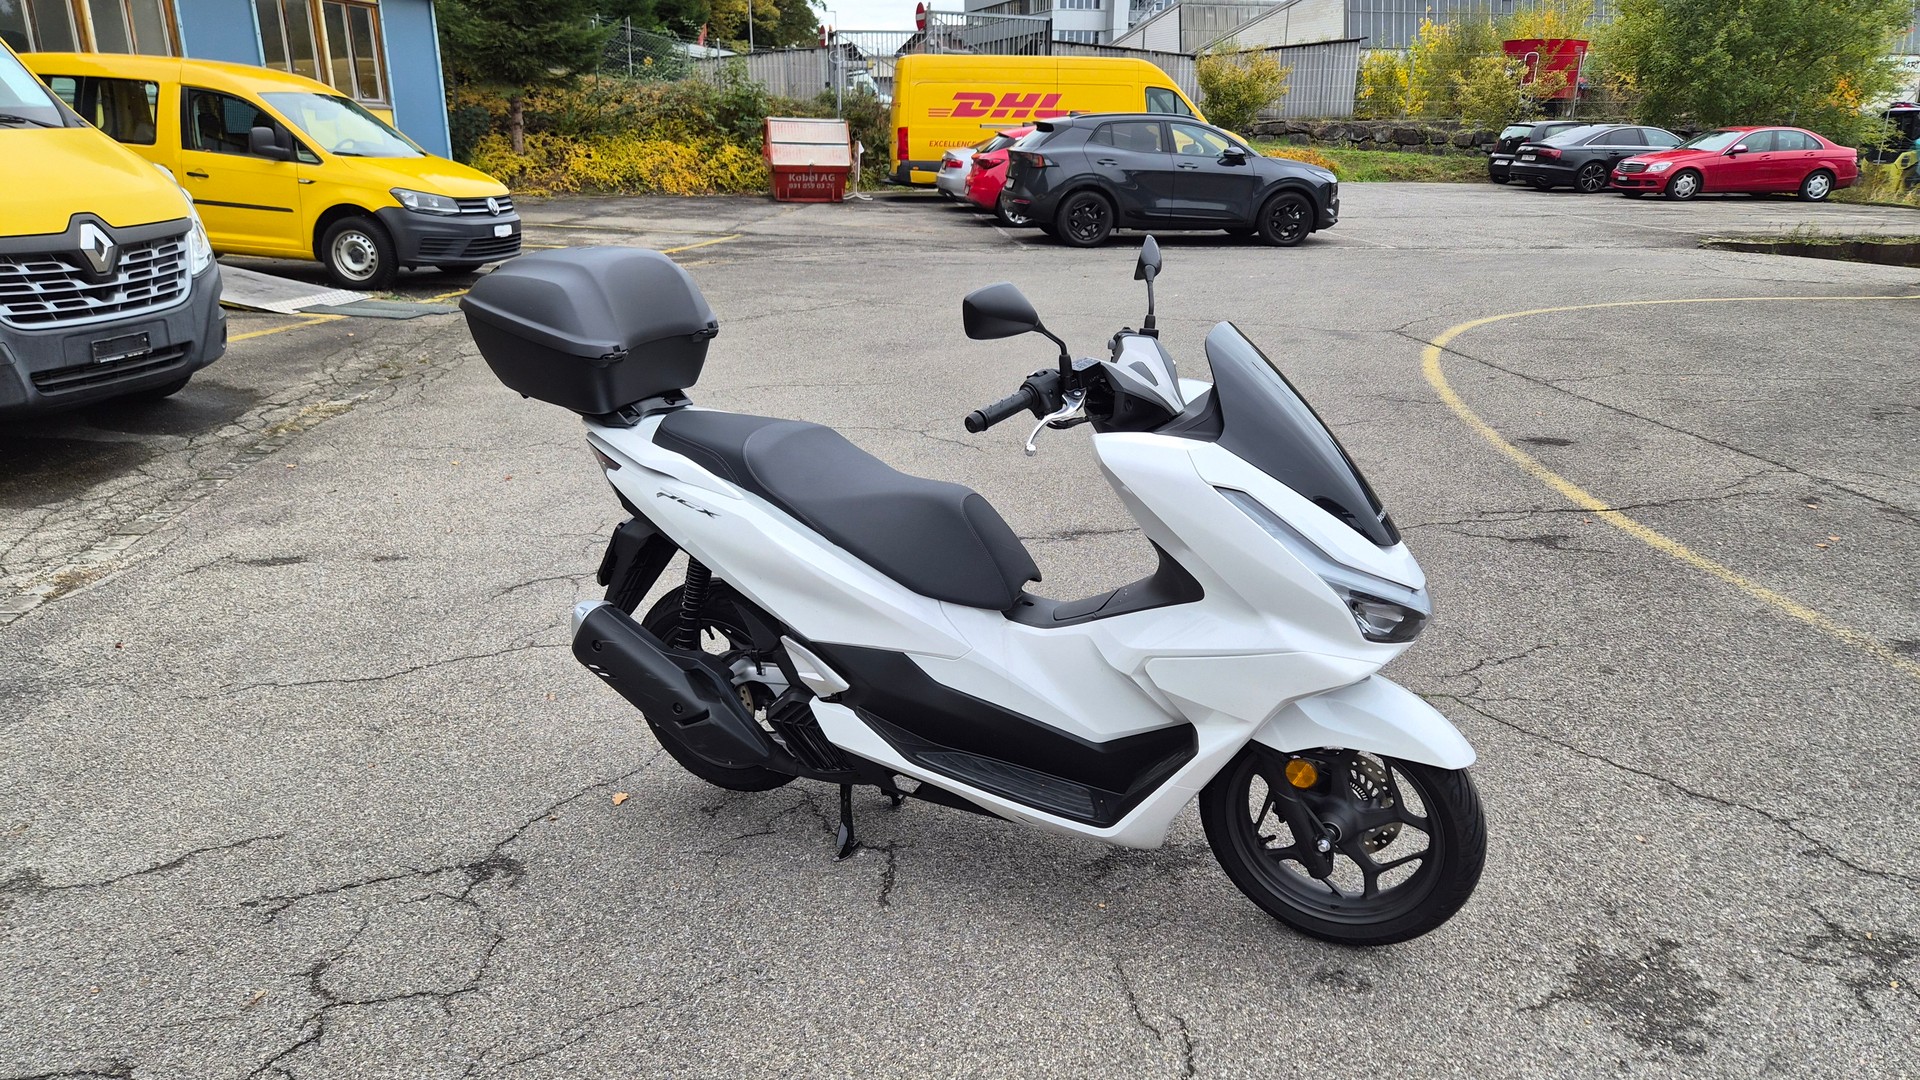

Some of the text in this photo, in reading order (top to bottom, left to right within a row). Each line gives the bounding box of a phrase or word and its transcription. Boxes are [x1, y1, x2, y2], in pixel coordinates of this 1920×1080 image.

[950, 92, 1070, 119] DHL
[788, 173, 836, 182] Kobel AG
